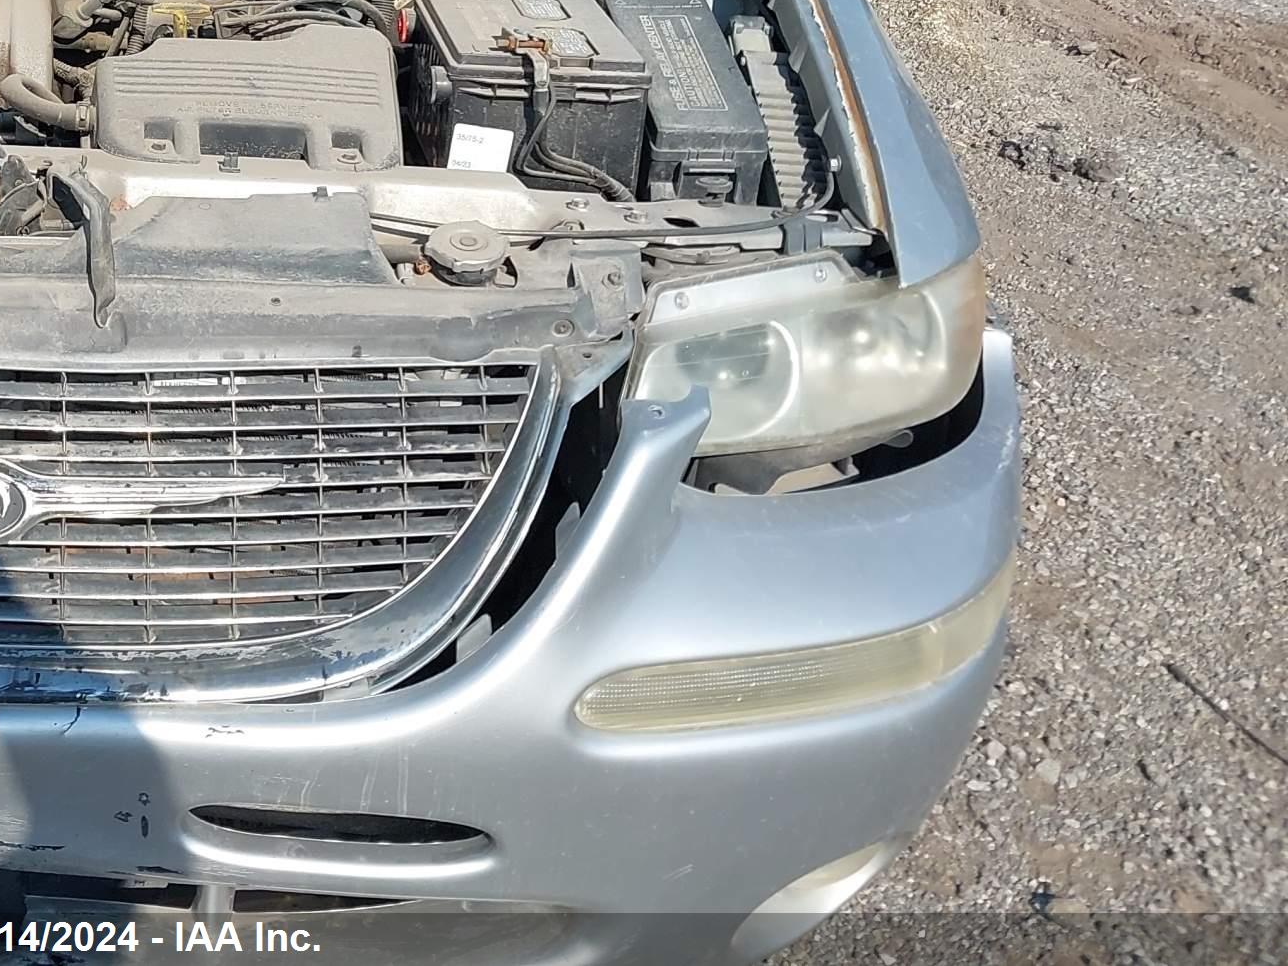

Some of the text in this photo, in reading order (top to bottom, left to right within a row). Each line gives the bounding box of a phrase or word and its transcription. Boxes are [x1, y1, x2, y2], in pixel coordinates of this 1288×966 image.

[639, 15, 662, 50] CENTER
[655, 51, 675, 78] RELAY
[669, 85, 689, 111] FUSE
